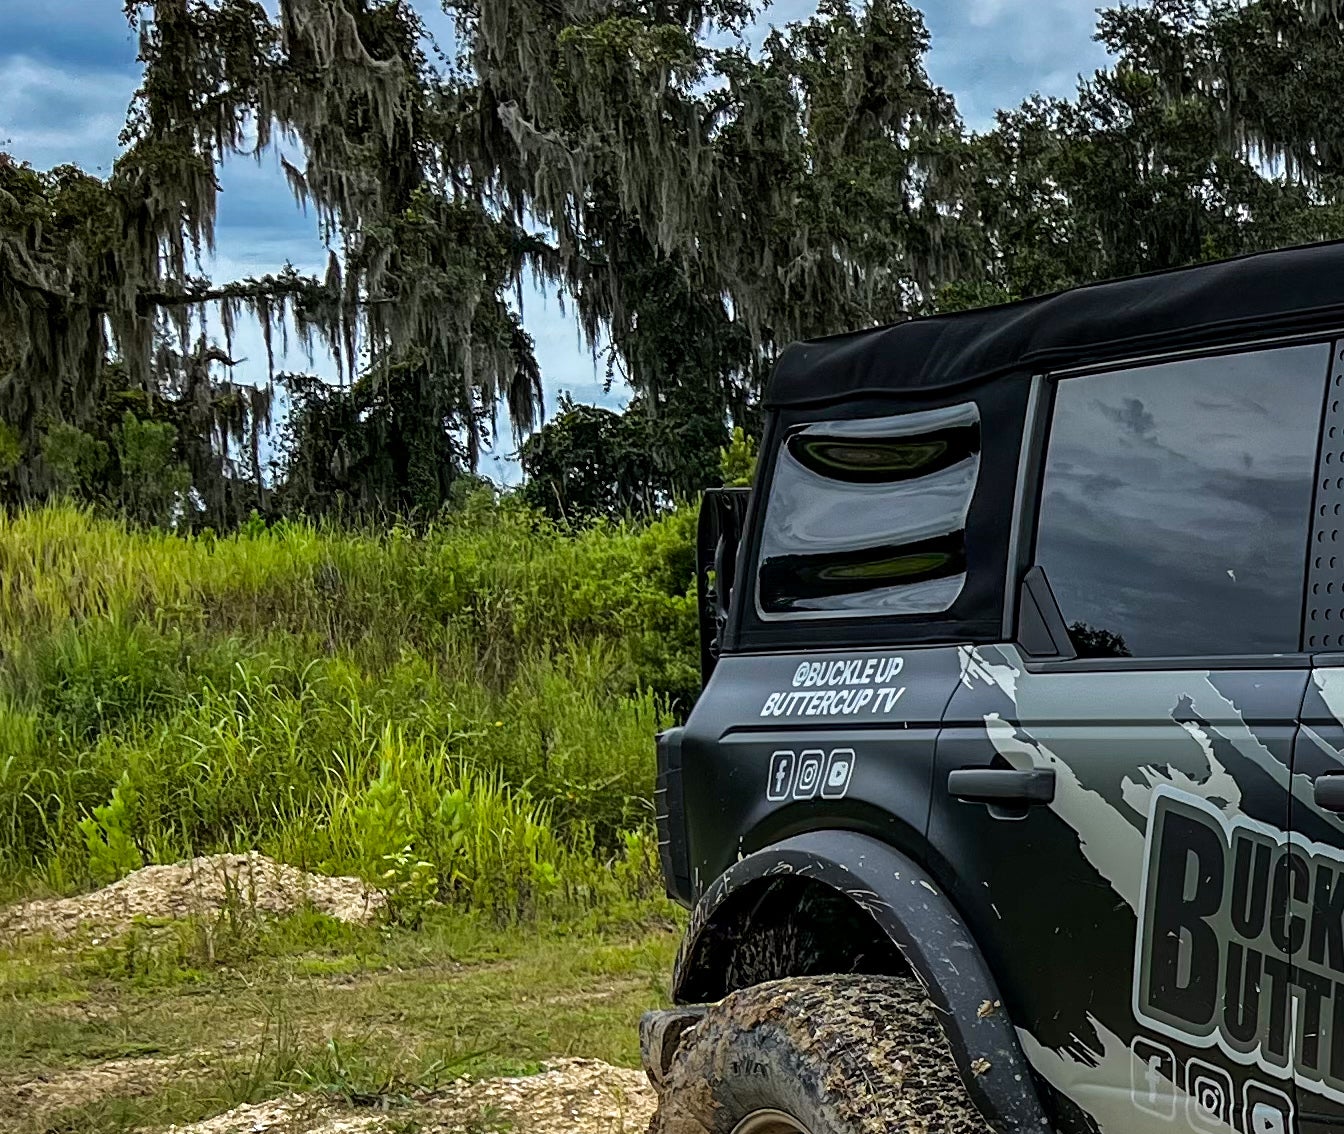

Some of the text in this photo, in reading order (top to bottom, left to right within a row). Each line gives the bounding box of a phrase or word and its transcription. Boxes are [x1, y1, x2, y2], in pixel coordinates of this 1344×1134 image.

[792, 657, 904, 687] @BUCKLE UP
[760, 687, 906, 717] BUTTERCUP TV
